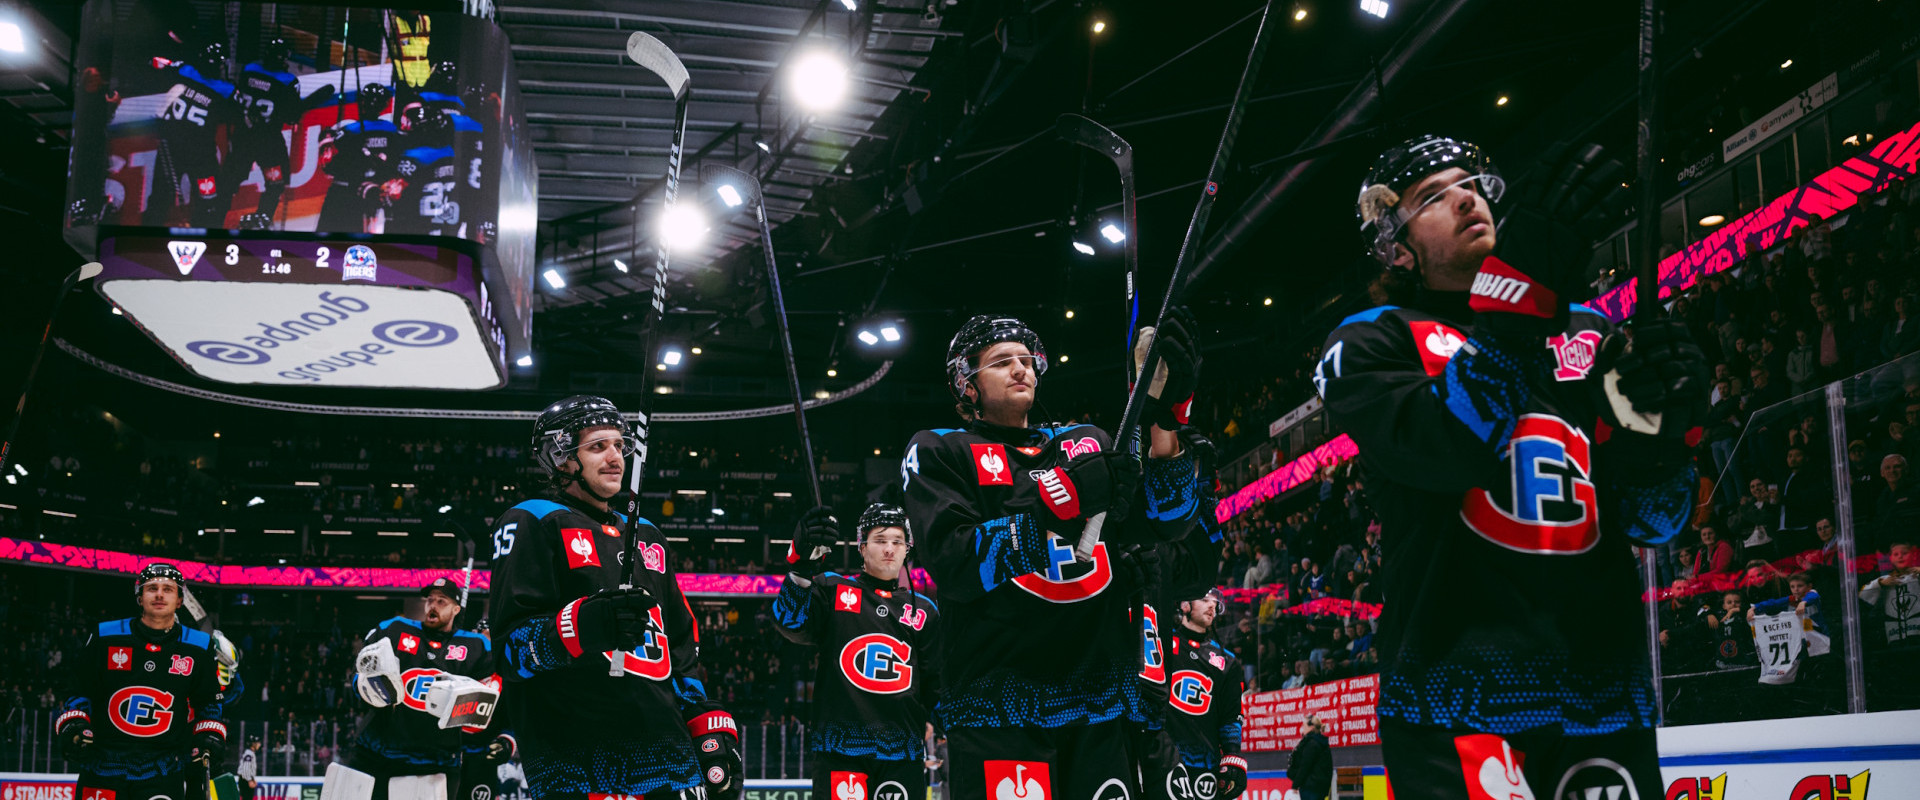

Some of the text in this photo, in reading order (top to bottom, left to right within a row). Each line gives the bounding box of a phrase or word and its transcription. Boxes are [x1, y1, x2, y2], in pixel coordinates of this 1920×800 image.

[1726, 136, 1748, 153] Allianz
[225, 244, 330, 268] 3 2
[262, 263, 292, 275] 1:46
[344, 266, 375, 280] TIGERS
[244, 291, 370, 350] groupe
[278, 342, 395, 382] groupe
[1565, 342, 1593, 367] CHL
[493, 523, 518, 560] 55
[1769, 641, 1791, 666] 71
[1314, 682, 1339, 695] STRAUSS
[1349, 676, 1375, 690] STRAUSS
[1306, 696, 1331, 709] STRAUSS
[1340, 691, 1367, 704] STRAUSS
[1349, 704, 1375, 717] STRAUSS
[1342, 719, 1367, 732] STRAUSS
[1350, 732, 1376, 744] STRAUSS
[15, 785, 73, 800] STRAUSS
